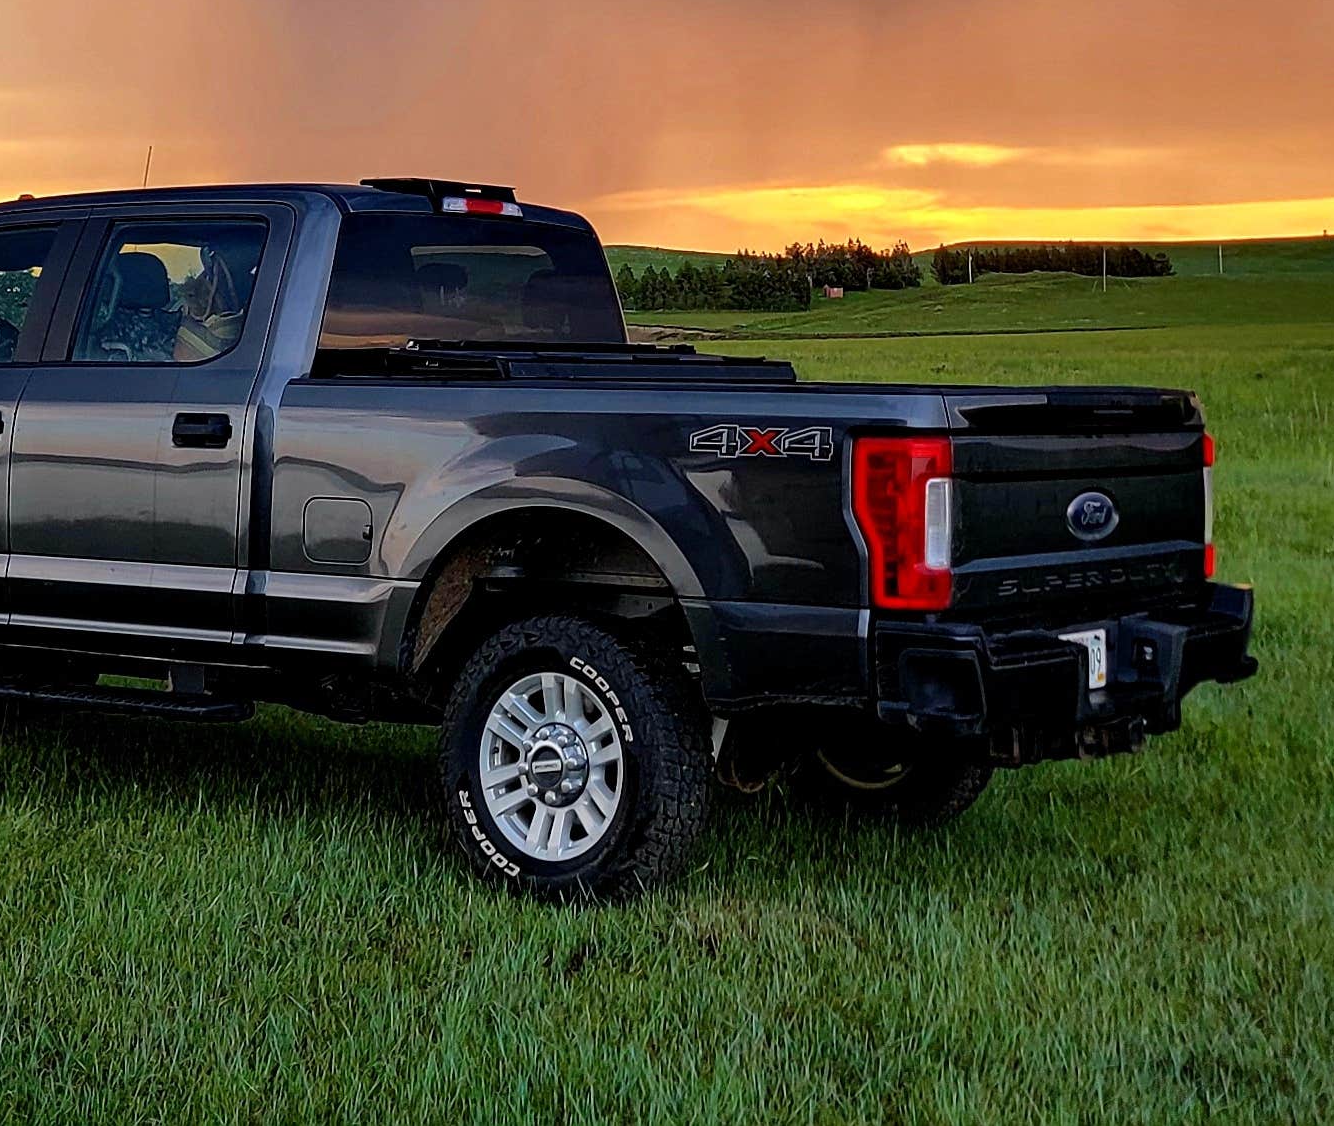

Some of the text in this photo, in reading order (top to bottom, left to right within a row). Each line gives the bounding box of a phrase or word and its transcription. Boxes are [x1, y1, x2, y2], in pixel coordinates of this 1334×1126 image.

[997, 571, 1103, 597] SUPER
[570, 656, 633, 743] COOPER
[459, 790, 520, 877] COOPER
